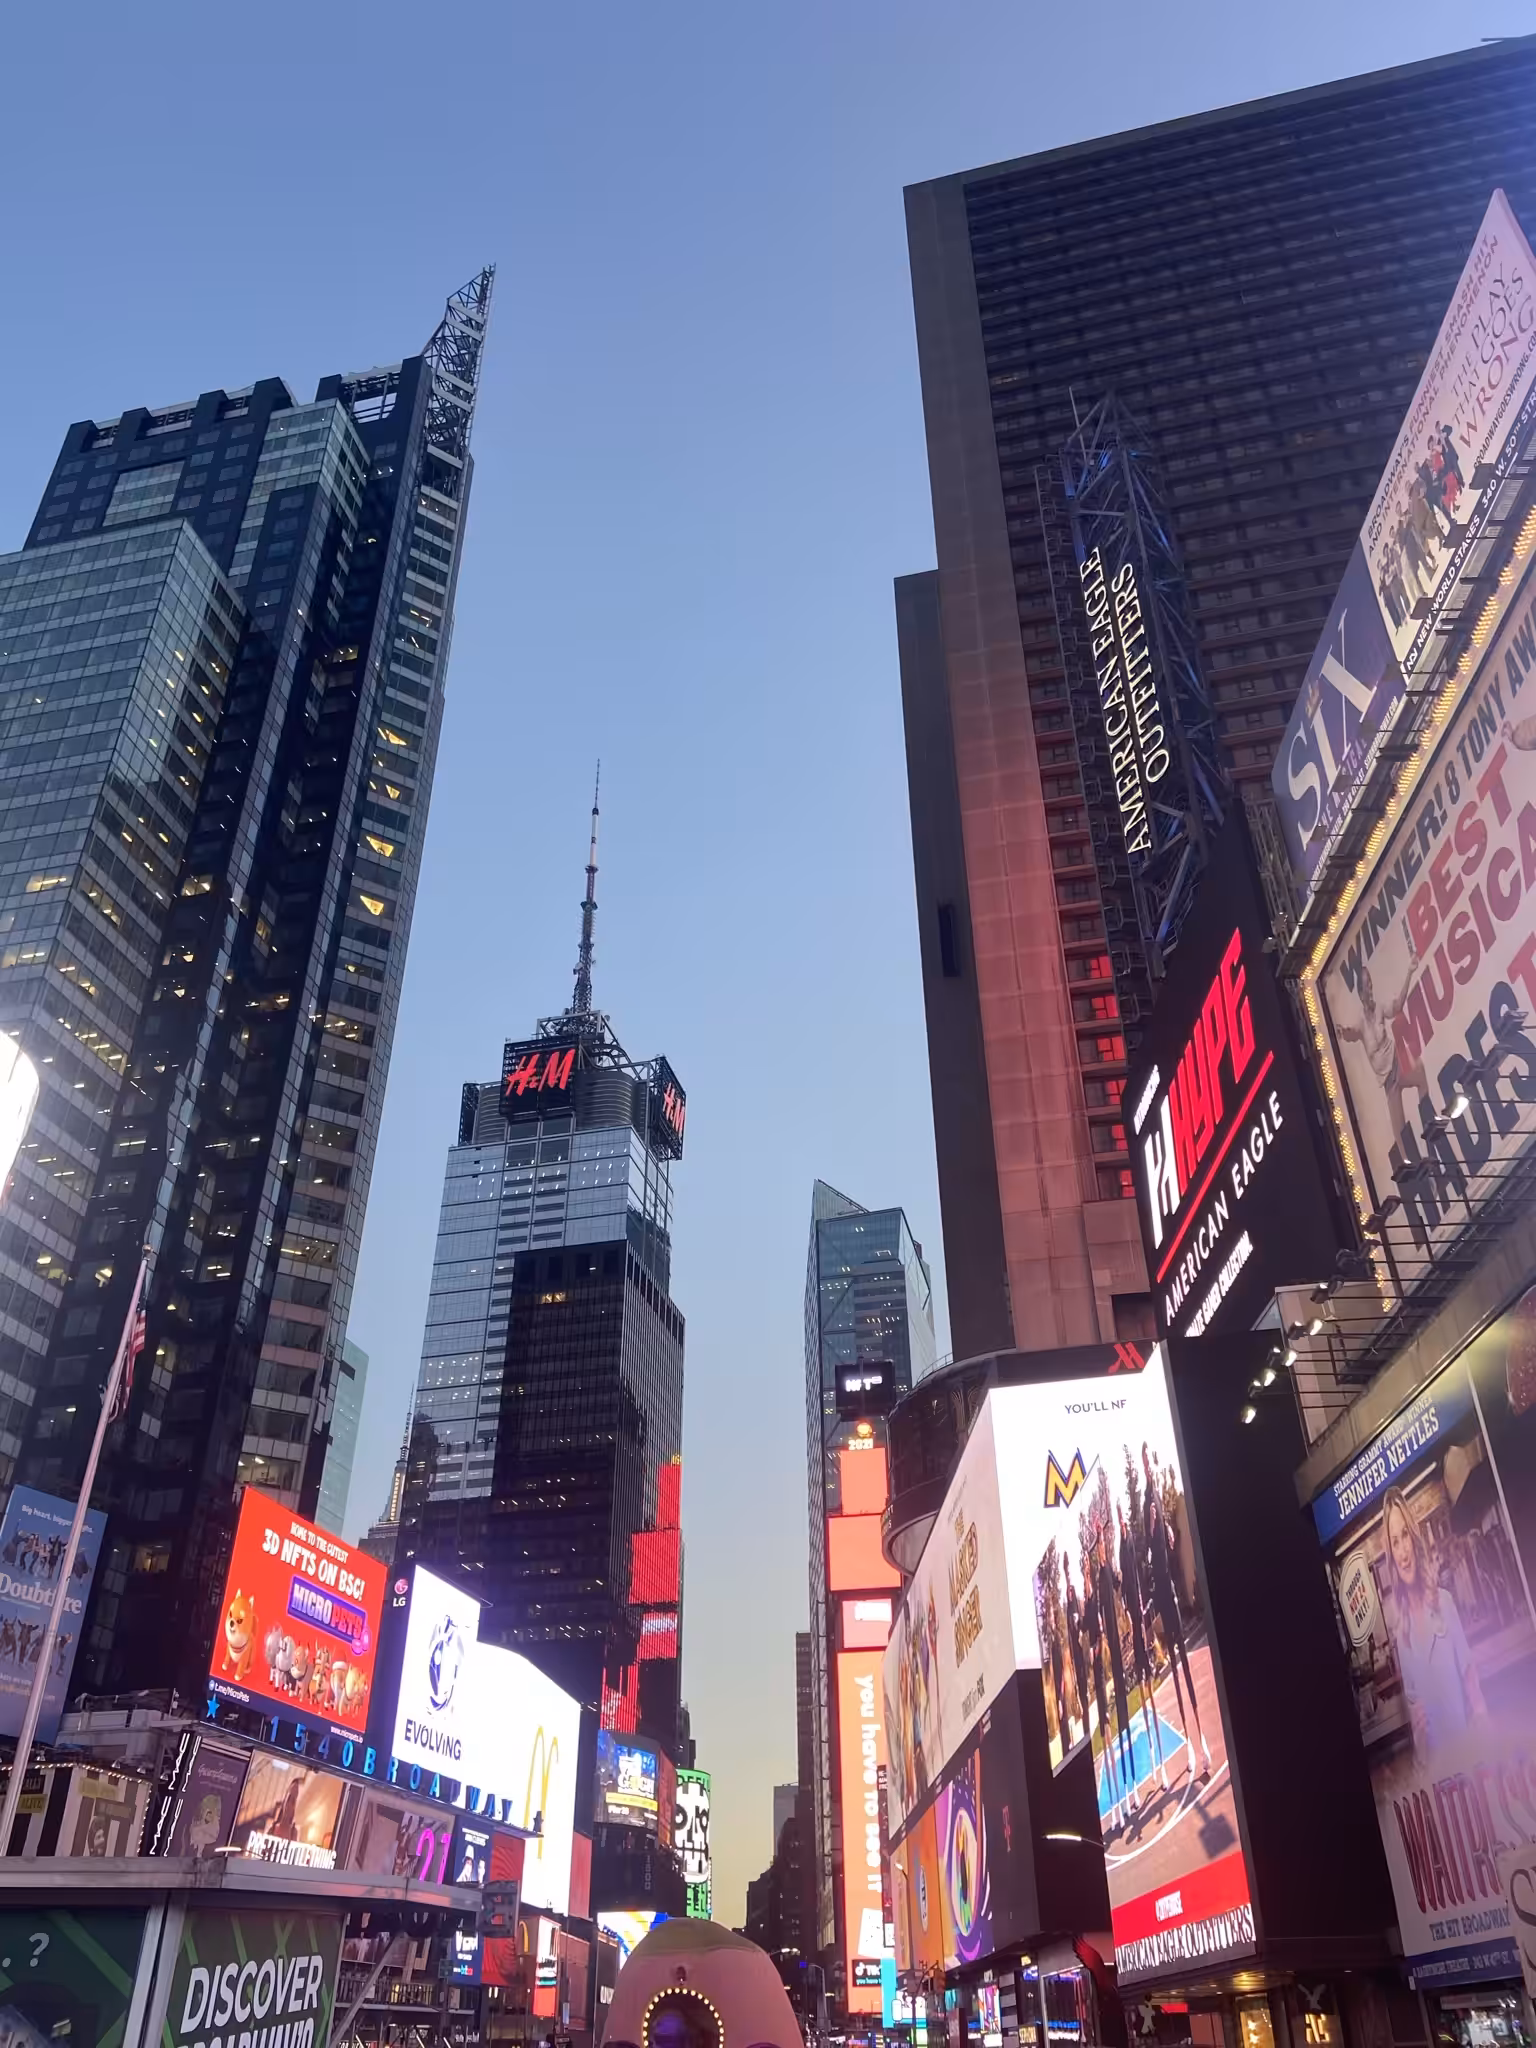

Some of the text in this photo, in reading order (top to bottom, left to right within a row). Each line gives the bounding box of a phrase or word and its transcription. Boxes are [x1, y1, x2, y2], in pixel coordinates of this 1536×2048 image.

[1451, 261, 1506, 397] THE PLAY
[1453, 266, 1523, 425] THAT GOES
[1368, 233, 1489, 538] BROADWAY'S FUNNIEST SMASH HIT
[1368, 235, 1498, 559] AND INTERNATIONAL PHENOMENON
[1459, 294, 1534, 449] WRONG
[1416, 614, 1433, 647] NEW
[1431, 567, 1456, 614] WORLD
[1454, 514, 1480, 568] STAGES
[1482, 479, 1497, 508] 340
[1495, 458, 1507, 477] W.
[1505, 423, 1521, 458] 50TH
[1080, 546, 1152, 854] AMERICAN EAGLE
[1111, 562, 1170, 784] OUTFITTERS
[1287, 608, 1378, 852] SIX
[1339, 782, 1448, 995] WINNER!
[1444, 760, 1460, 806] 8
[1456, 671, 1506, 781] TONY
[1405, 742, 1512, 962] BEST
[505, 1048, 576, 1097] H&M
[662, 1081, 686, 1142] H&M
[1165, 1090, 1284, 1327] AMERICAN EAGLE
[1201, 1282, 1223, 1325] GAMER
[1064, 1401, 1109, 1415] YOU'LL
[1333, 1465, 1359, 1498] STARRING
[1357, 1441, 1384, 1472] GRAMMY
[1337, 1406, 1440, 1520] JENNIFER NETTLES
[262, 1528, 366, 1602] 3D NFTS ON BSC!
[290, 1521, 349, 1564] HOME TO THE CUTEST
[0, 1572, 82, 1615] Doubtre
[393, 1597, 407, 1608] LG
[404, 1718, 462, 1762] EVOLVING
[245, 1830, 337, 1871] PRETTYLITTLETHING
[415, 1827, 452, 1887] 21
[1184, 1904, 1256, 1958] OUTFITTERS
[1429, 1906, 1511, 1942] THE HIT BROADWAY
[180, 1954, 324, 2034] DISCOVER
